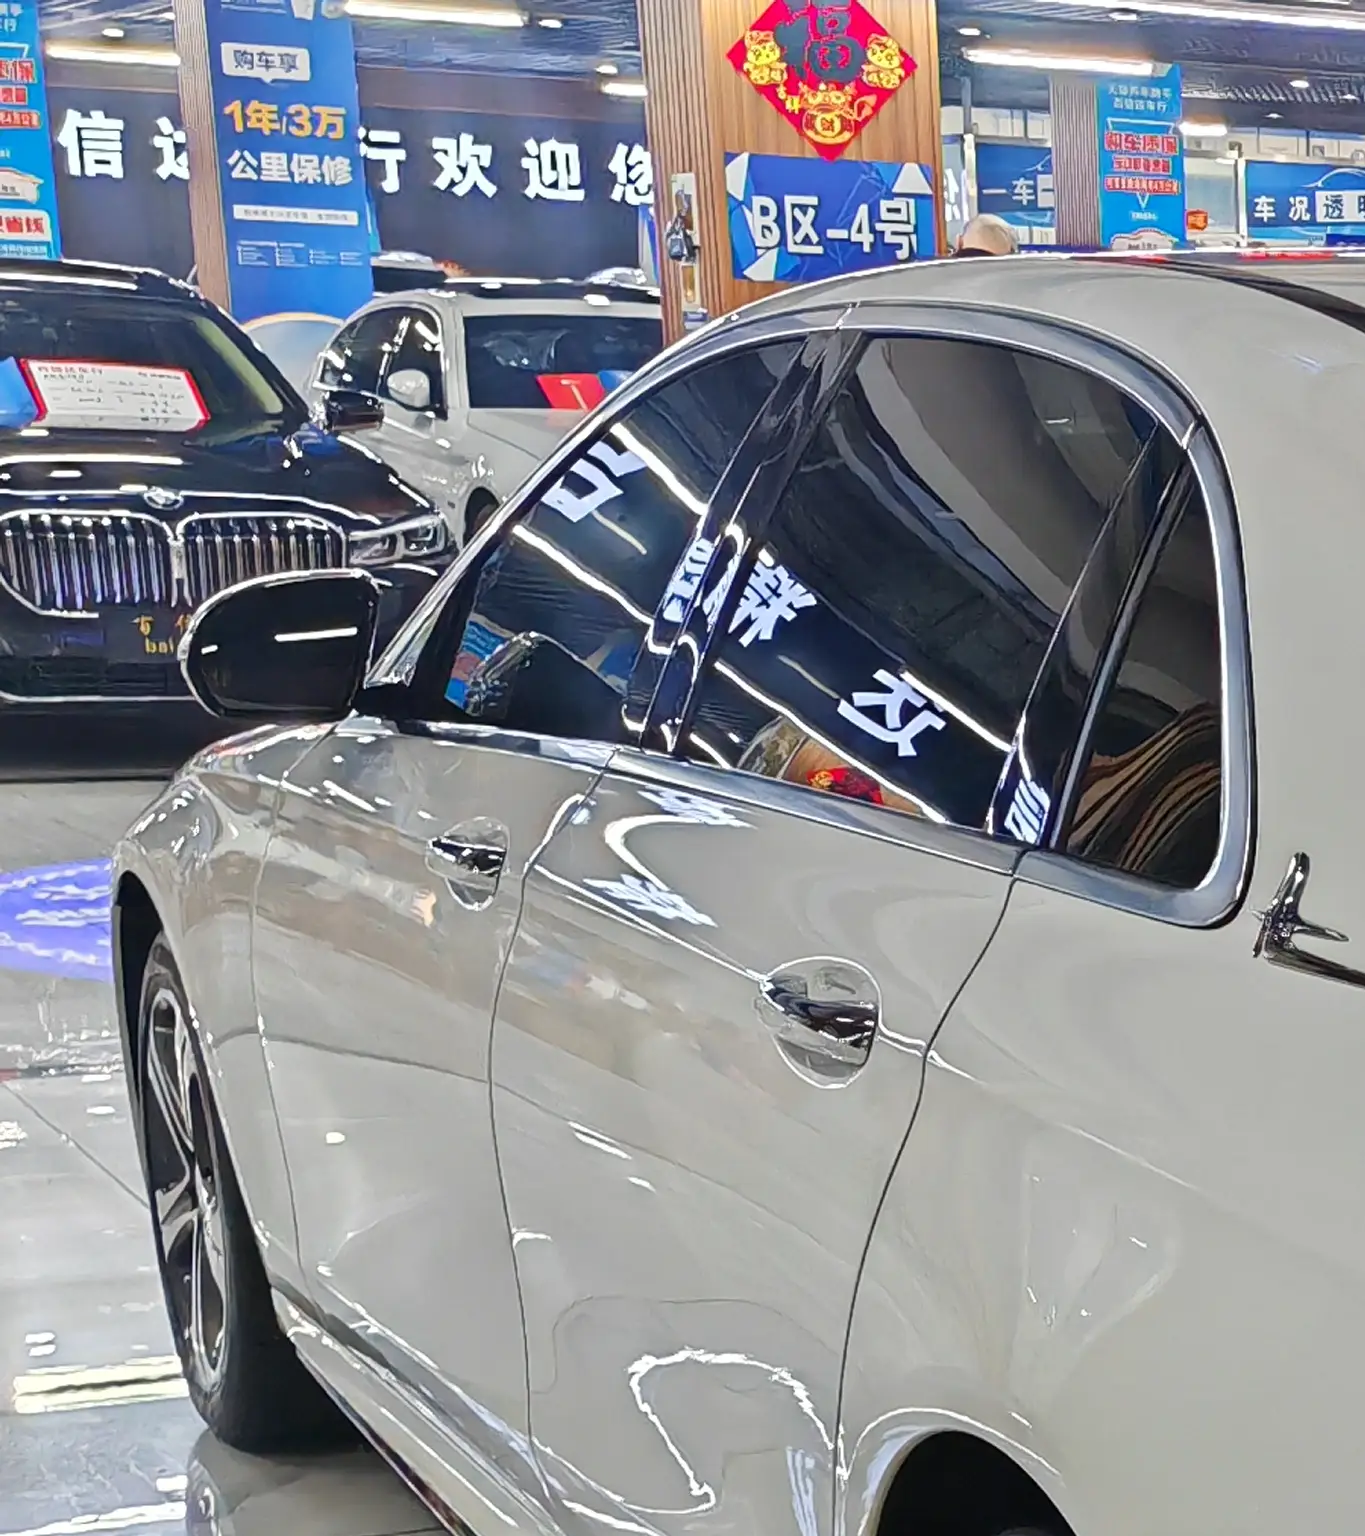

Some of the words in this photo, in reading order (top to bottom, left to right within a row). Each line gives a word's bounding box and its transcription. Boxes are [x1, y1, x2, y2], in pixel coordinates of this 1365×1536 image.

[223, 100, 347, 139] 1年/3万
[227, 149, 353, 186] 公里保修
[751, 194, 916, 261] B区-4号
